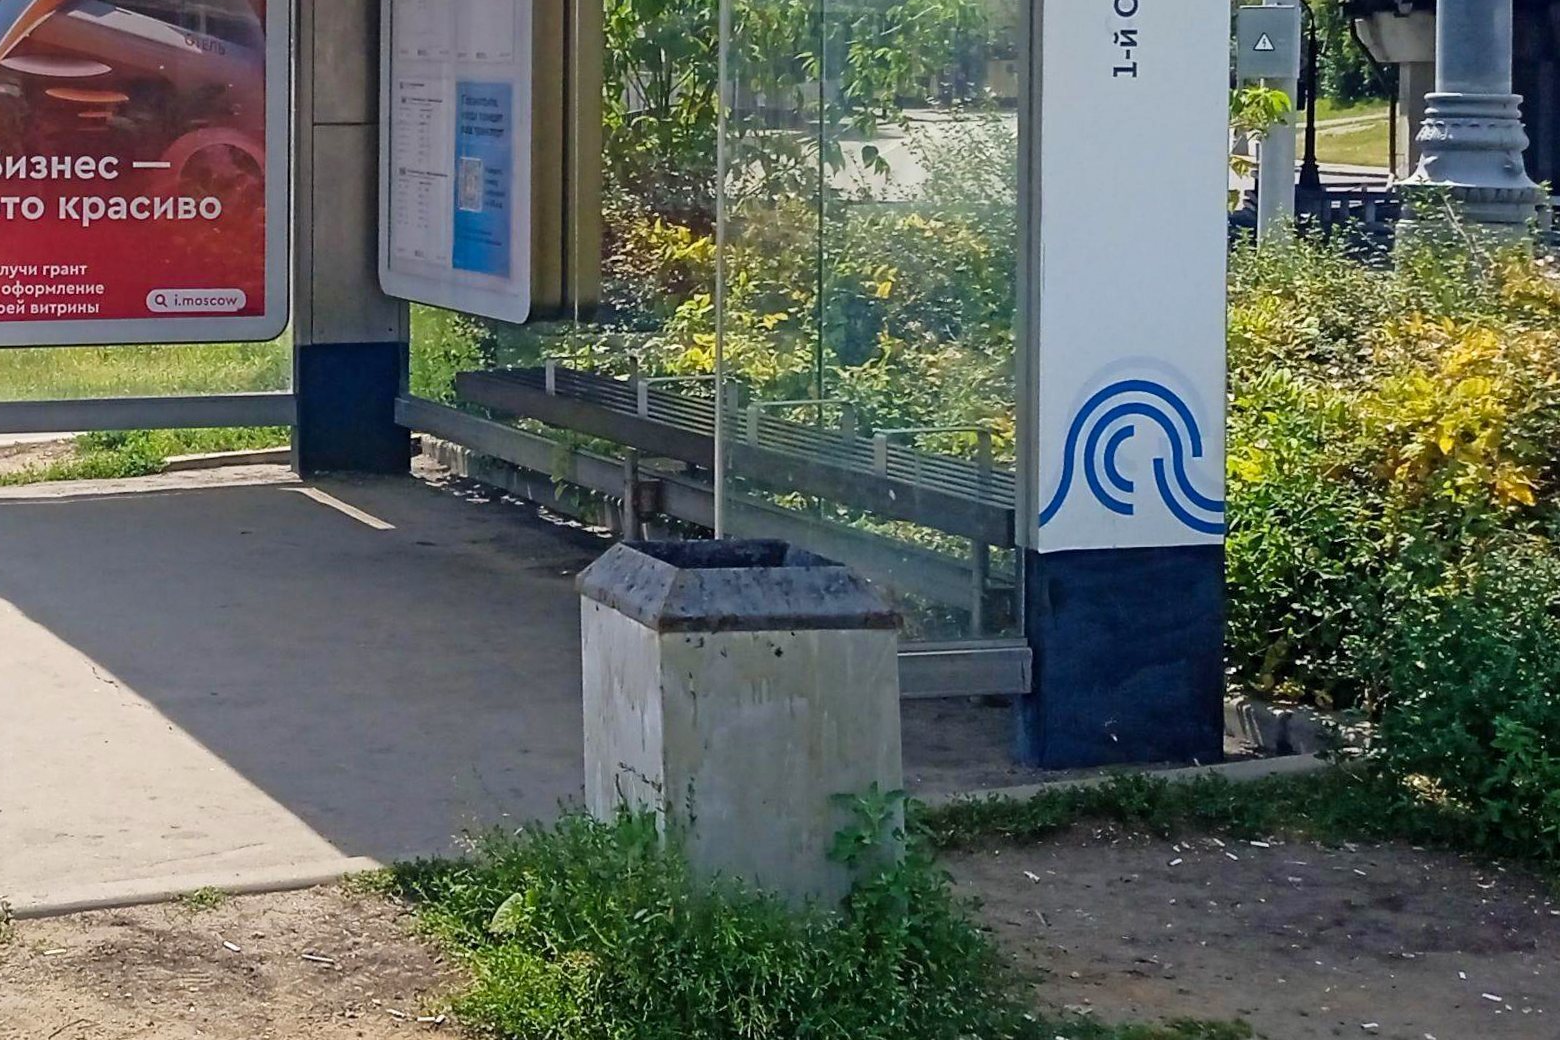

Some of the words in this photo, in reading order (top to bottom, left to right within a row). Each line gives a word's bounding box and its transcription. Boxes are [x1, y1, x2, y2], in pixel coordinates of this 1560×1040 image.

[1112, 30, 1138, 78] 1-й
[58, 196, 222, 227] красиво
[42, 264, 88, 277] грант
[1, 280, 104, 298] оформление
[174, 294, 238, 307] i.moscow
[30, 303, 100, 317] витрины
